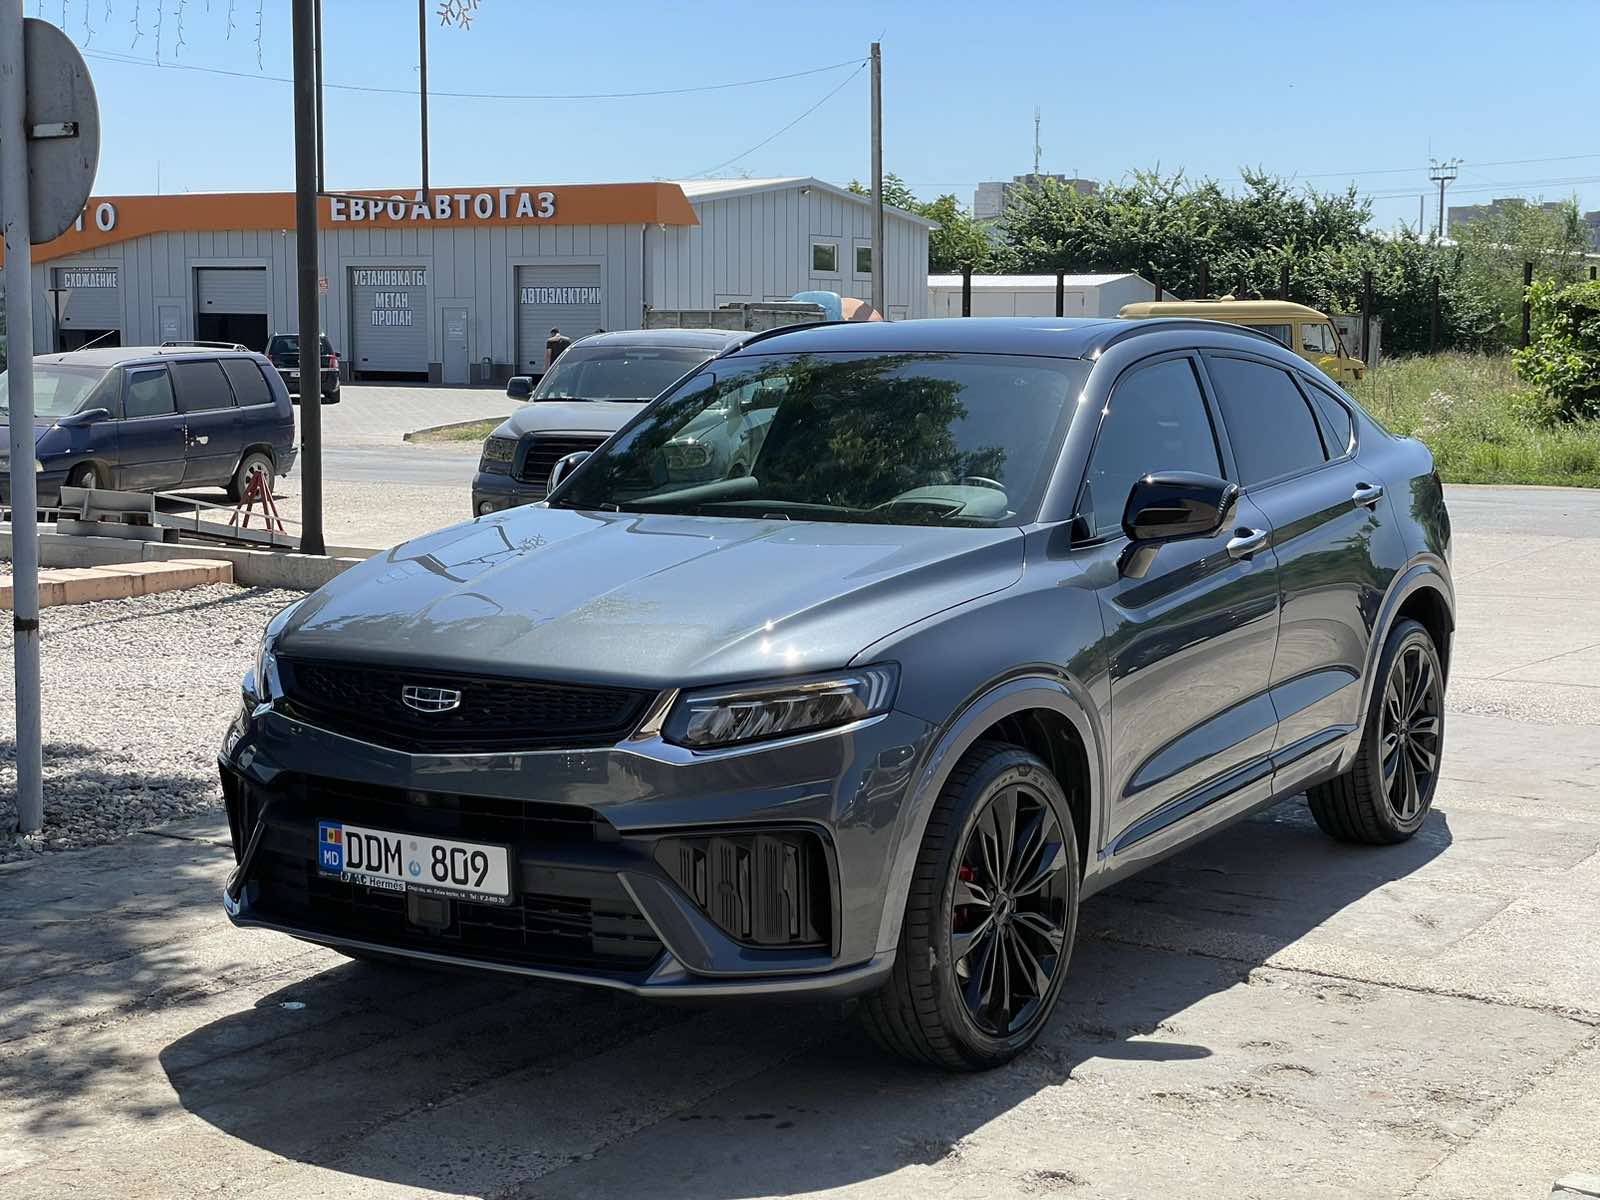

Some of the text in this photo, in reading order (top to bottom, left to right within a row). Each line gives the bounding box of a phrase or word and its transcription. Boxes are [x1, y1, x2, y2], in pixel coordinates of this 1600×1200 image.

[64, 272, 117, 288] СХОЖДЕНИЕ
[353, 270, 410, 286] УСТАНОВКА
[375, 292, 408, 308] МЕТАН
[371, 310, 412, 326] ПРОПАН
[324, 831, 489, 888] MD DDM 809
